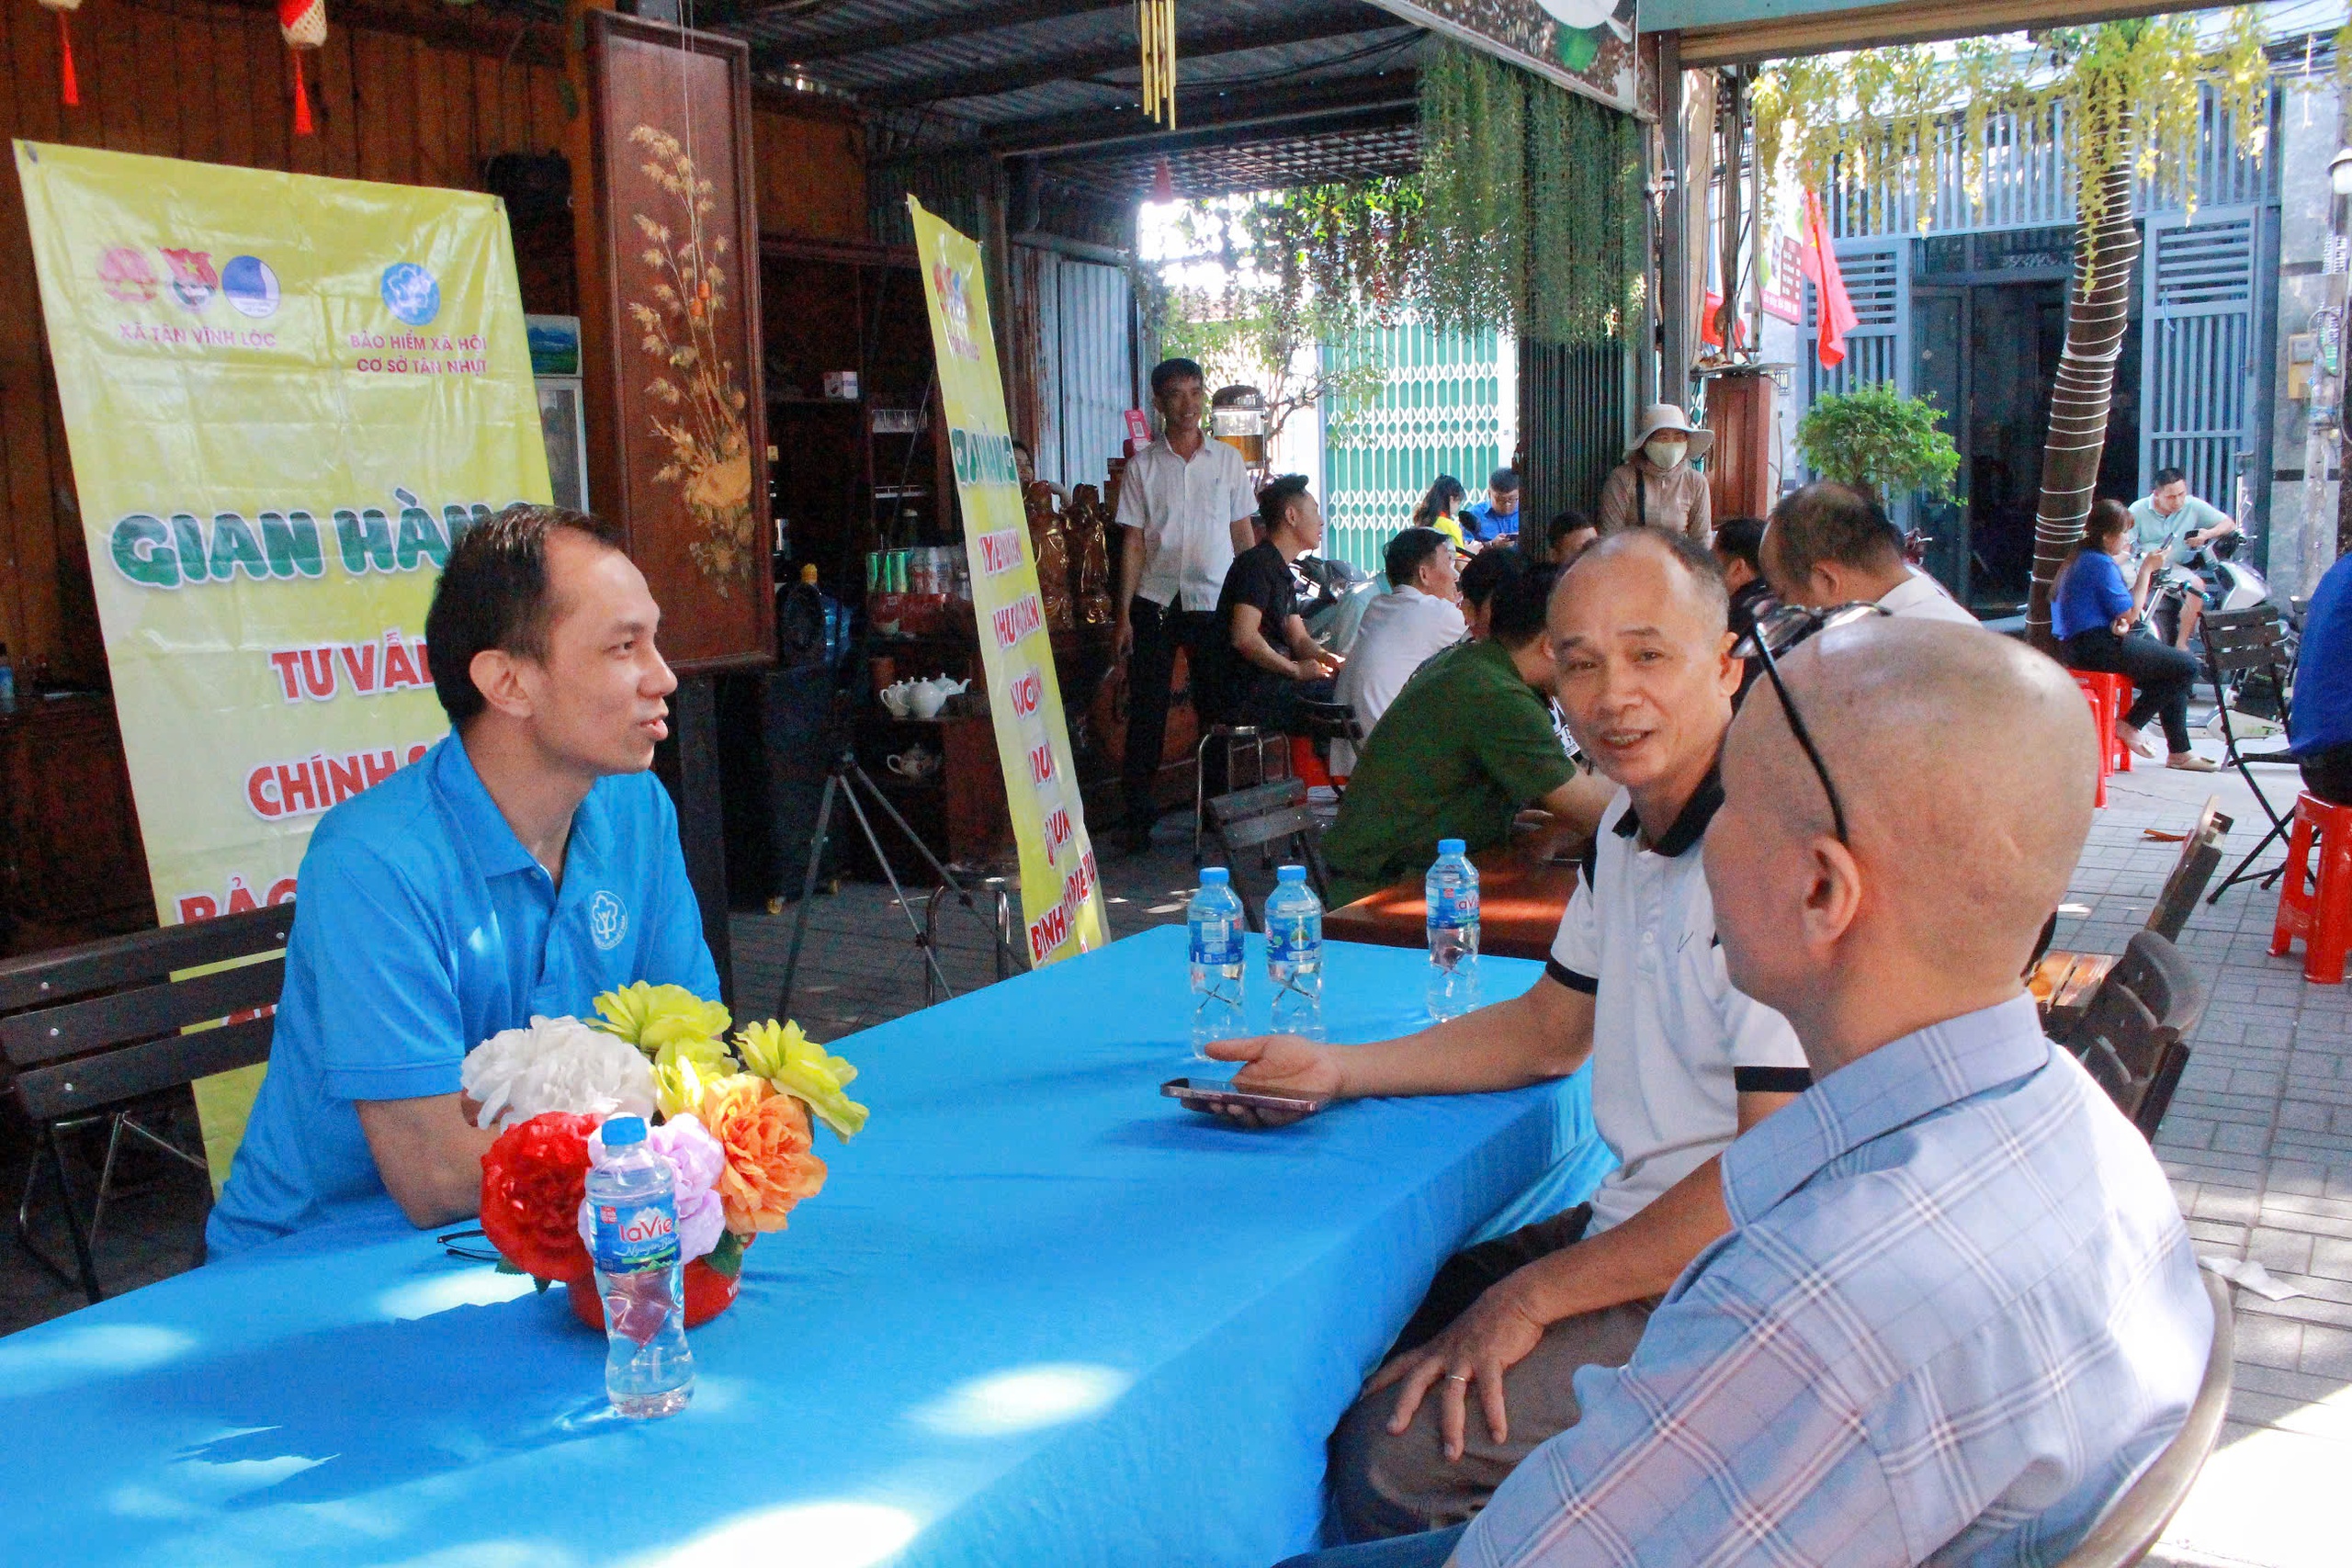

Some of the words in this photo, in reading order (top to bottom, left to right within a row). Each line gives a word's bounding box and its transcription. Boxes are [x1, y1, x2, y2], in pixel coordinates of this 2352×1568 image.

[119, 321, 147, 341] XÃ
[151, 323, 187, 344] TÂN
[191, 326, 236, 345] VĨNH
[241, 328, 276, 351] LỘC
[350, 330, 386, 349] BẢO
[390, 329, 426, 351] HIỂM
[430, 333, 454, 351] XÃ
[458, 333, 488, 354] HỘI
[356, 356, 382, 373] CƠ
[388, 355, 408, 374] SỞ
[413, 356, 443, 374] TÂN
[110, 513, 325, 588] GIAN
[618, 1215, 673, 1242] laVie
